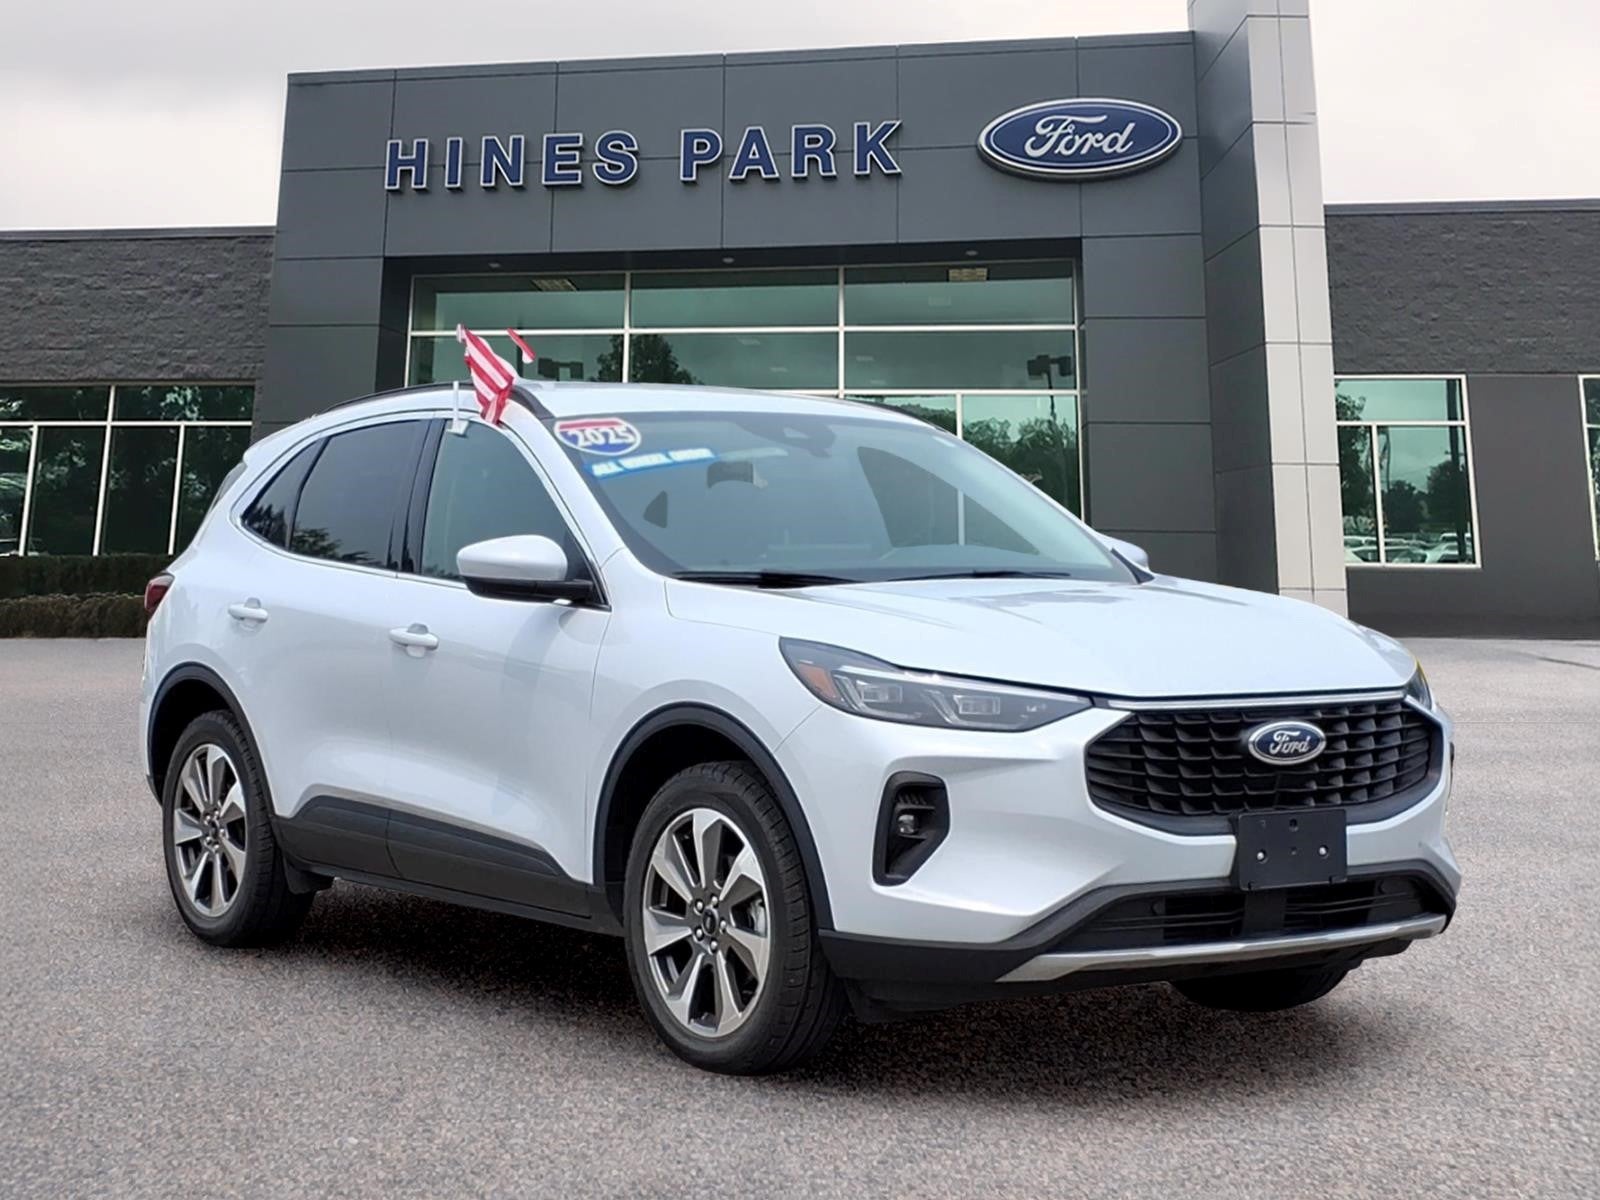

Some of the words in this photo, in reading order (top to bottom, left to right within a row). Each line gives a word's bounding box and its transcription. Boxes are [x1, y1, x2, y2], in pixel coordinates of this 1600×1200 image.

[1024, 115, 1136, 158] Ford
[384, 131, 639, 191] HINES
[679, 120, 903, 183] PARK
[567, 427, 635, 447] 2025
[1269, 730, 1311, 754] Ford
